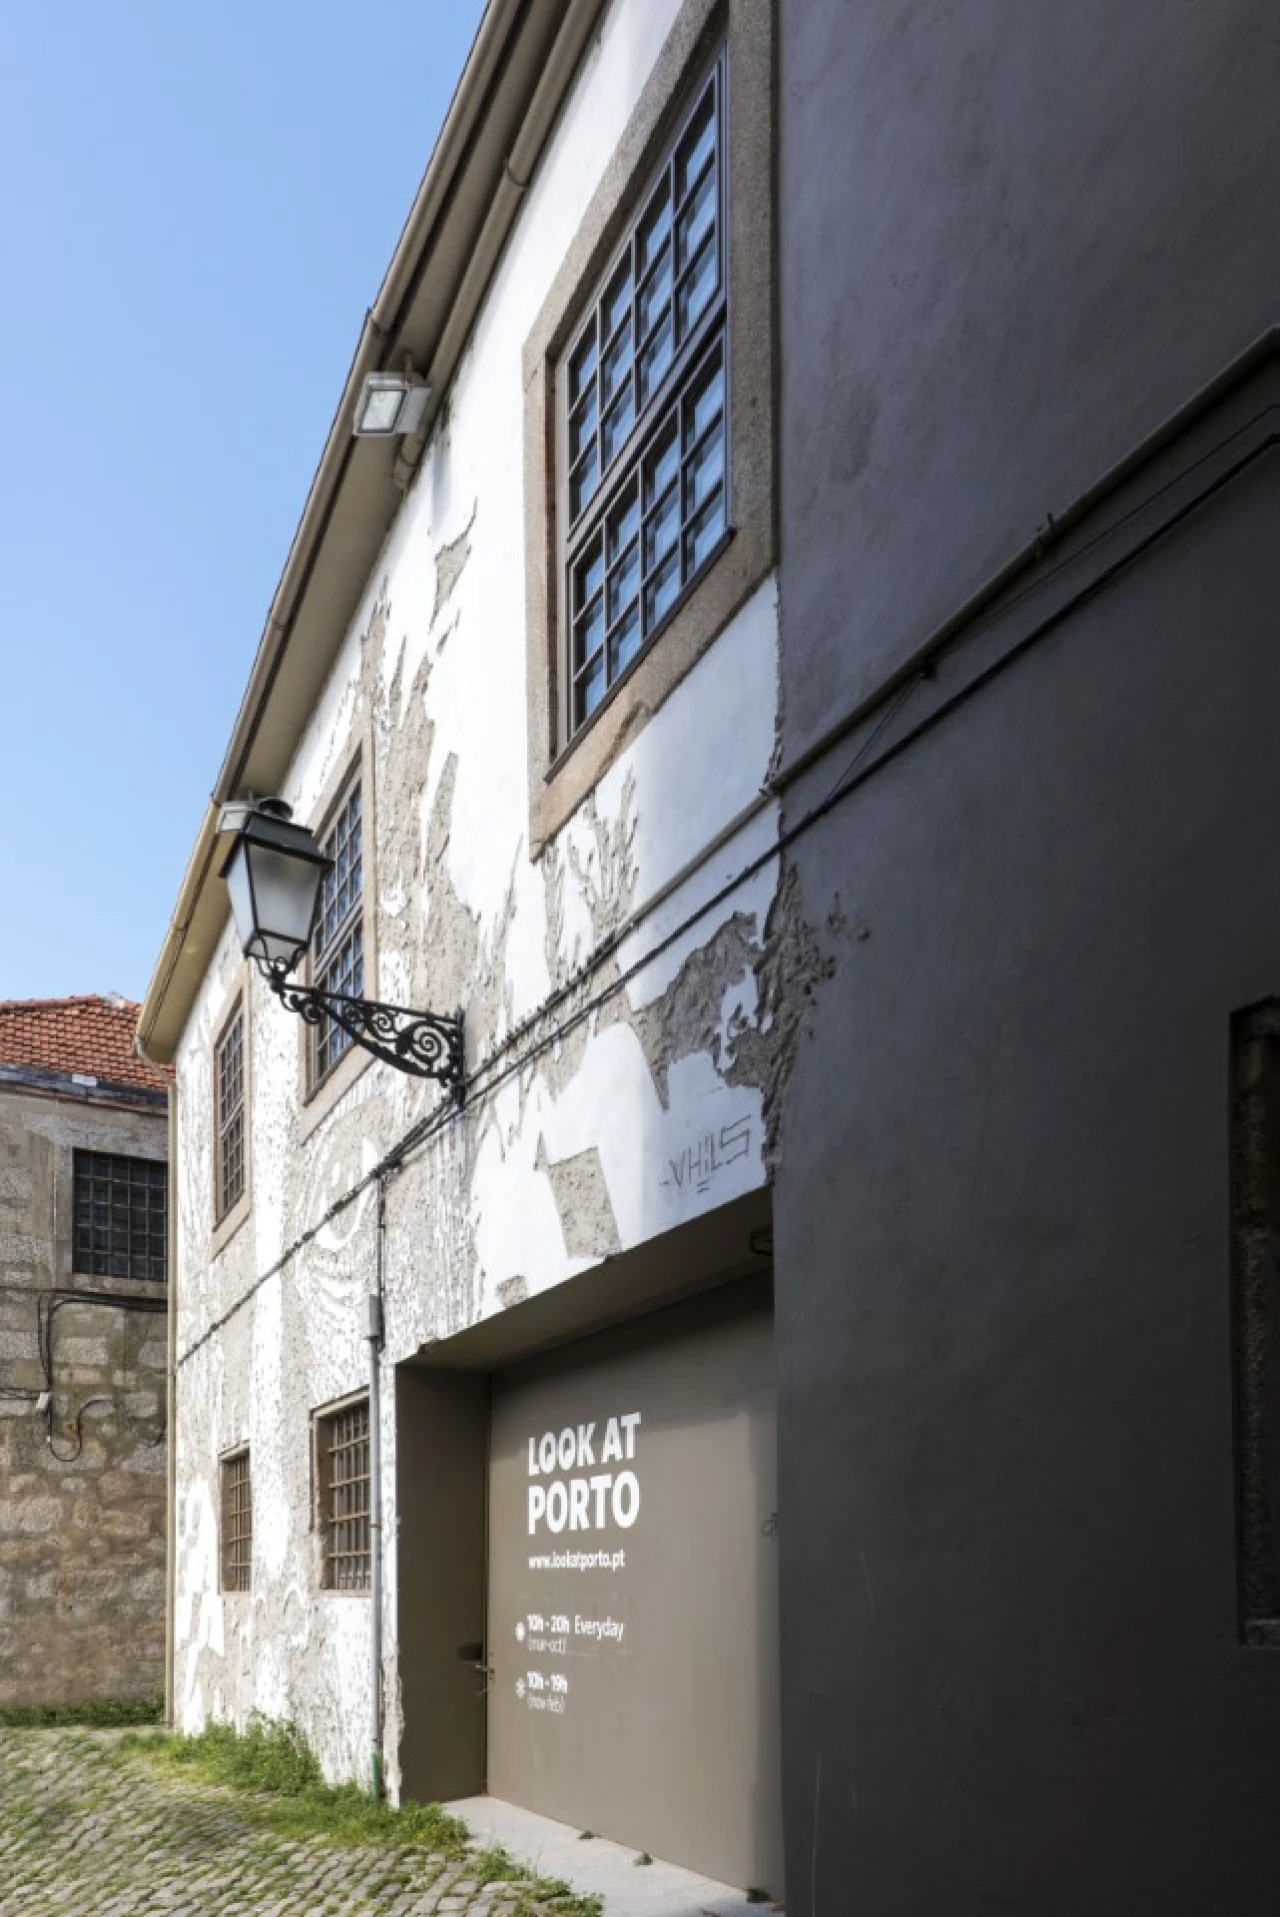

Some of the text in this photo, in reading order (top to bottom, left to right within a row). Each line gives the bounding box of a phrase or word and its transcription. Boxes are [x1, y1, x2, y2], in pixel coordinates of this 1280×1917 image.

[528, 1411, 641, 1476] LOOK AT
[528, 1470, 640, 1535] PORTO
[528, 1549, 625, 1572] www.lookatporto.pt
[527, 1613, 543, 1632] 10h
[574, 1615, 624, 1642] Everyday
[527, 1671, 543, 1690] 10h
